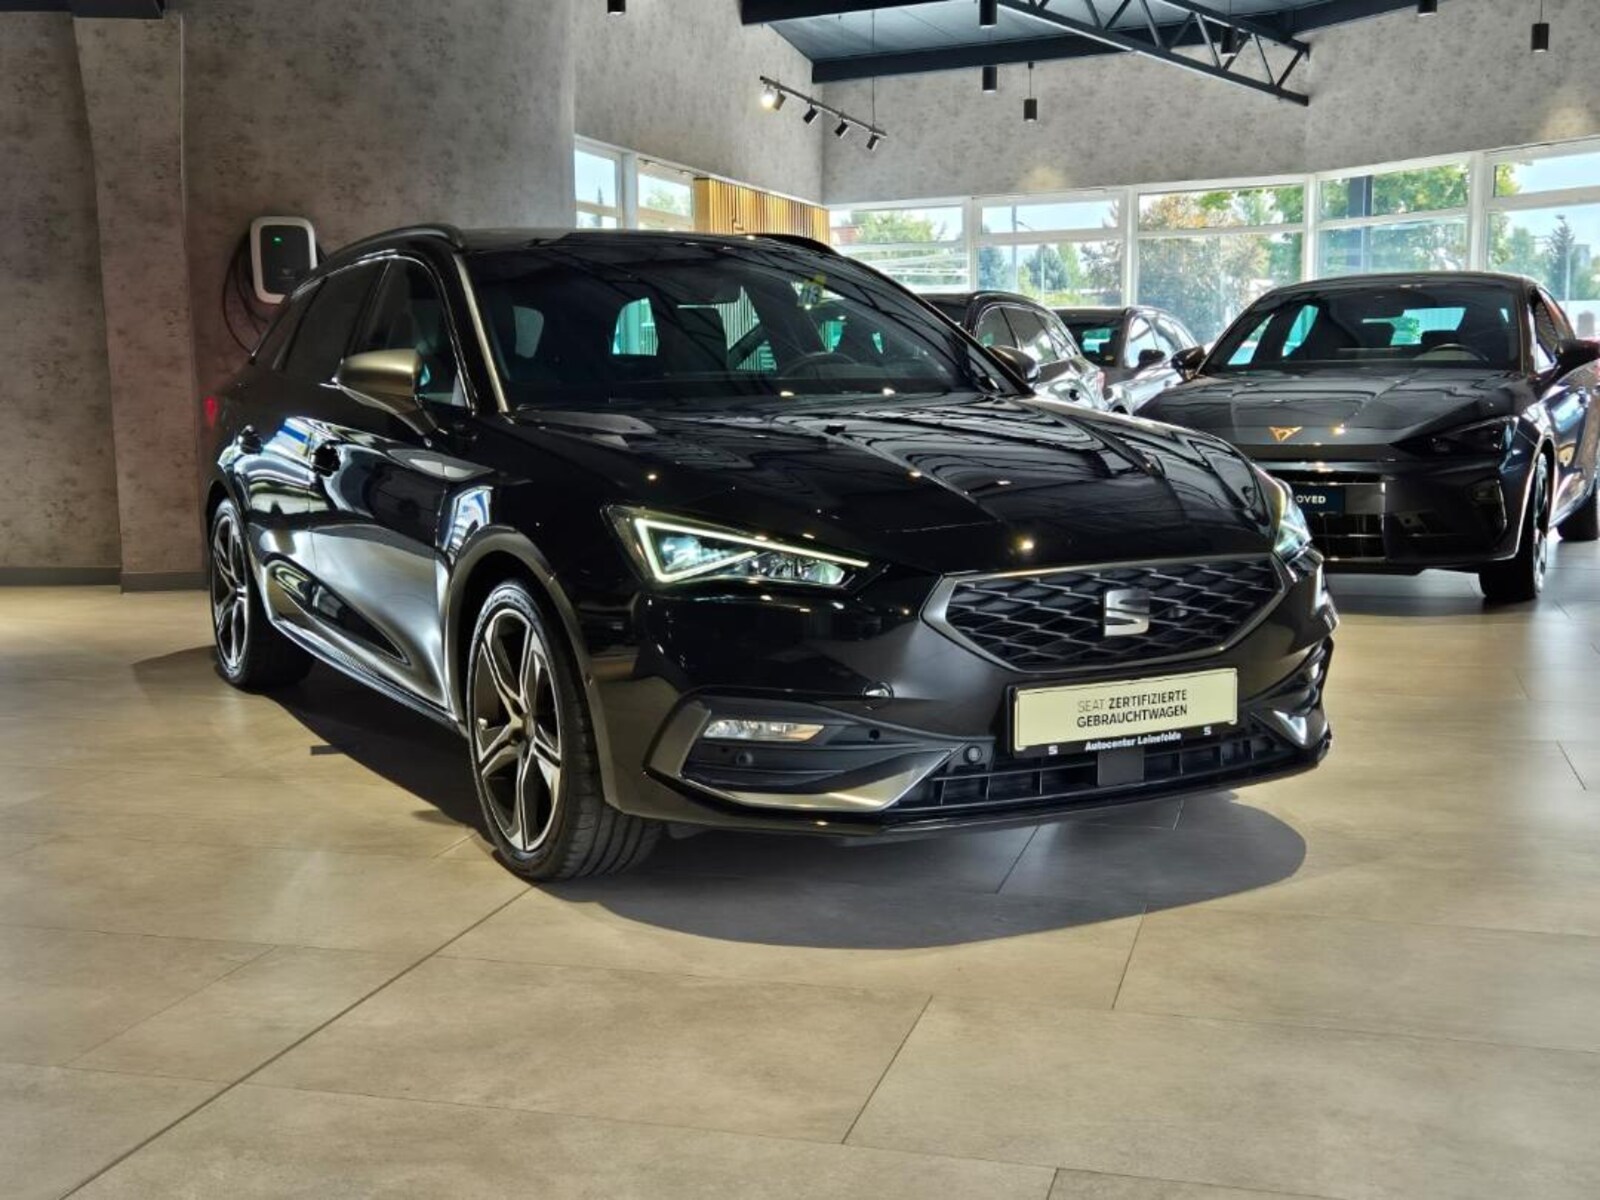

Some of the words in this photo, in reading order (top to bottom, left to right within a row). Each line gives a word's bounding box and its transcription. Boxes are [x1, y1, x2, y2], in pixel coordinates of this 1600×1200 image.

[1295, 494, 1327, 504] OVED
[1077, 699, 1106, 713] SEAT
[1109, 689, 1187, 710] ZERTIFIZIERTE
[1076, 704, 1188, 728] GEBRAUCHTWAGEN
[1085, 738, 1136, 751] Autocenter
